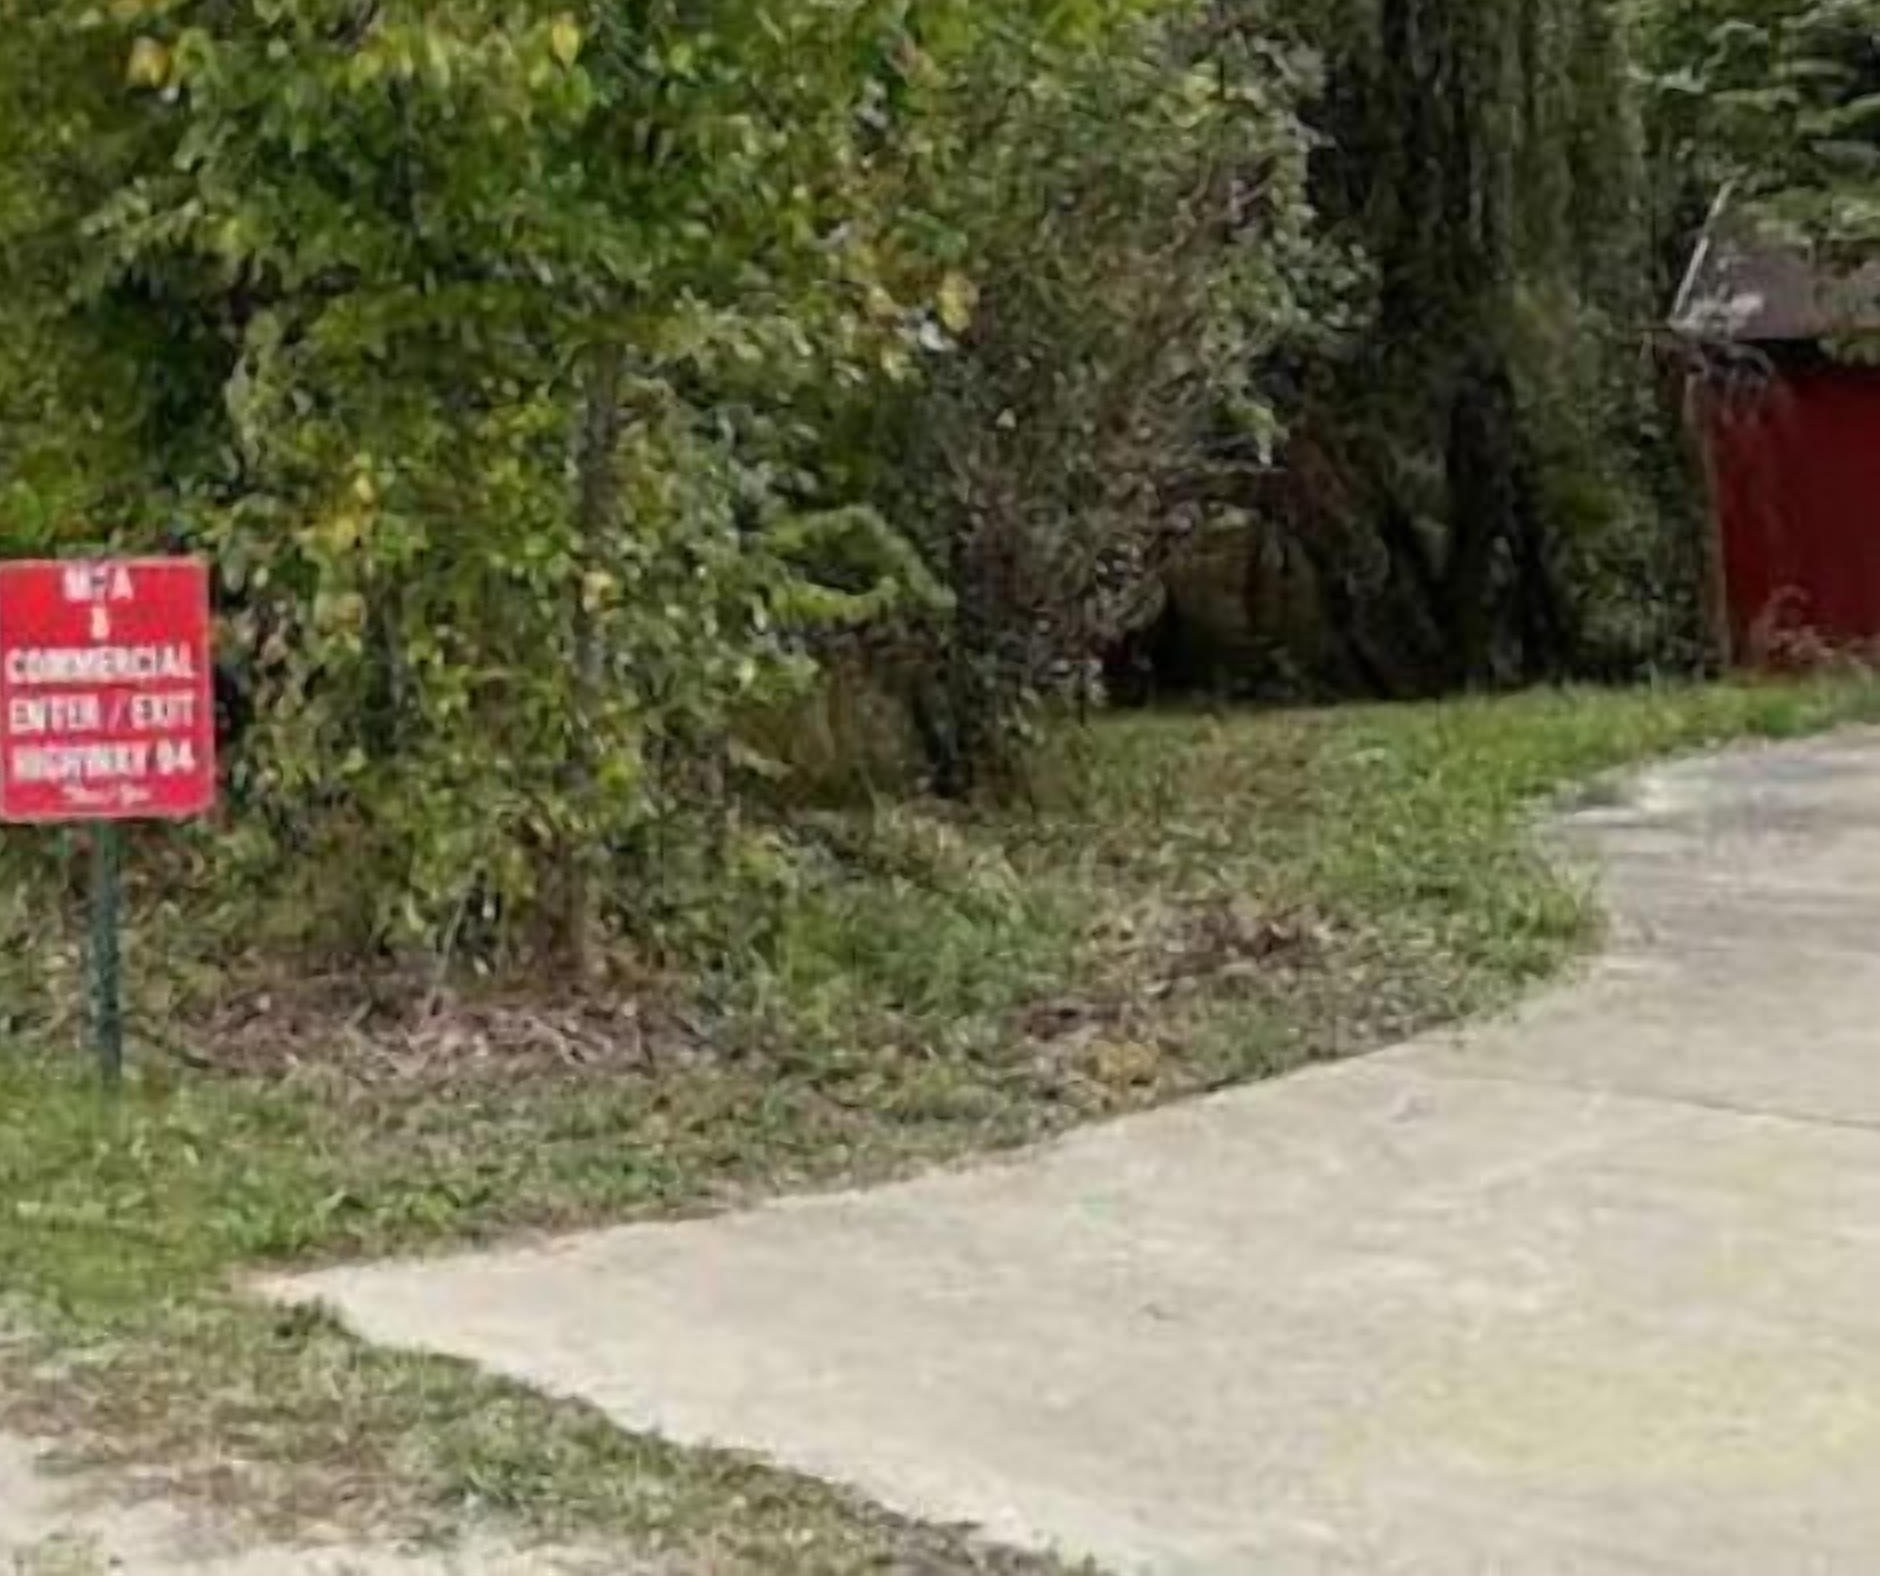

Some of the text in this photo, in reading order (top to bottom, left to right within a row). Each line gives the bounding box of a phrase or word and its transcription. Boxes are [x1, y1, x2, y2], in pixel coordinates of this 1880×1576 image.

[6, 643, 194, 684] COMMERCIAL
[10, 693, 100, 734] ENTER
[130, 689, 195, 730] EXIT
